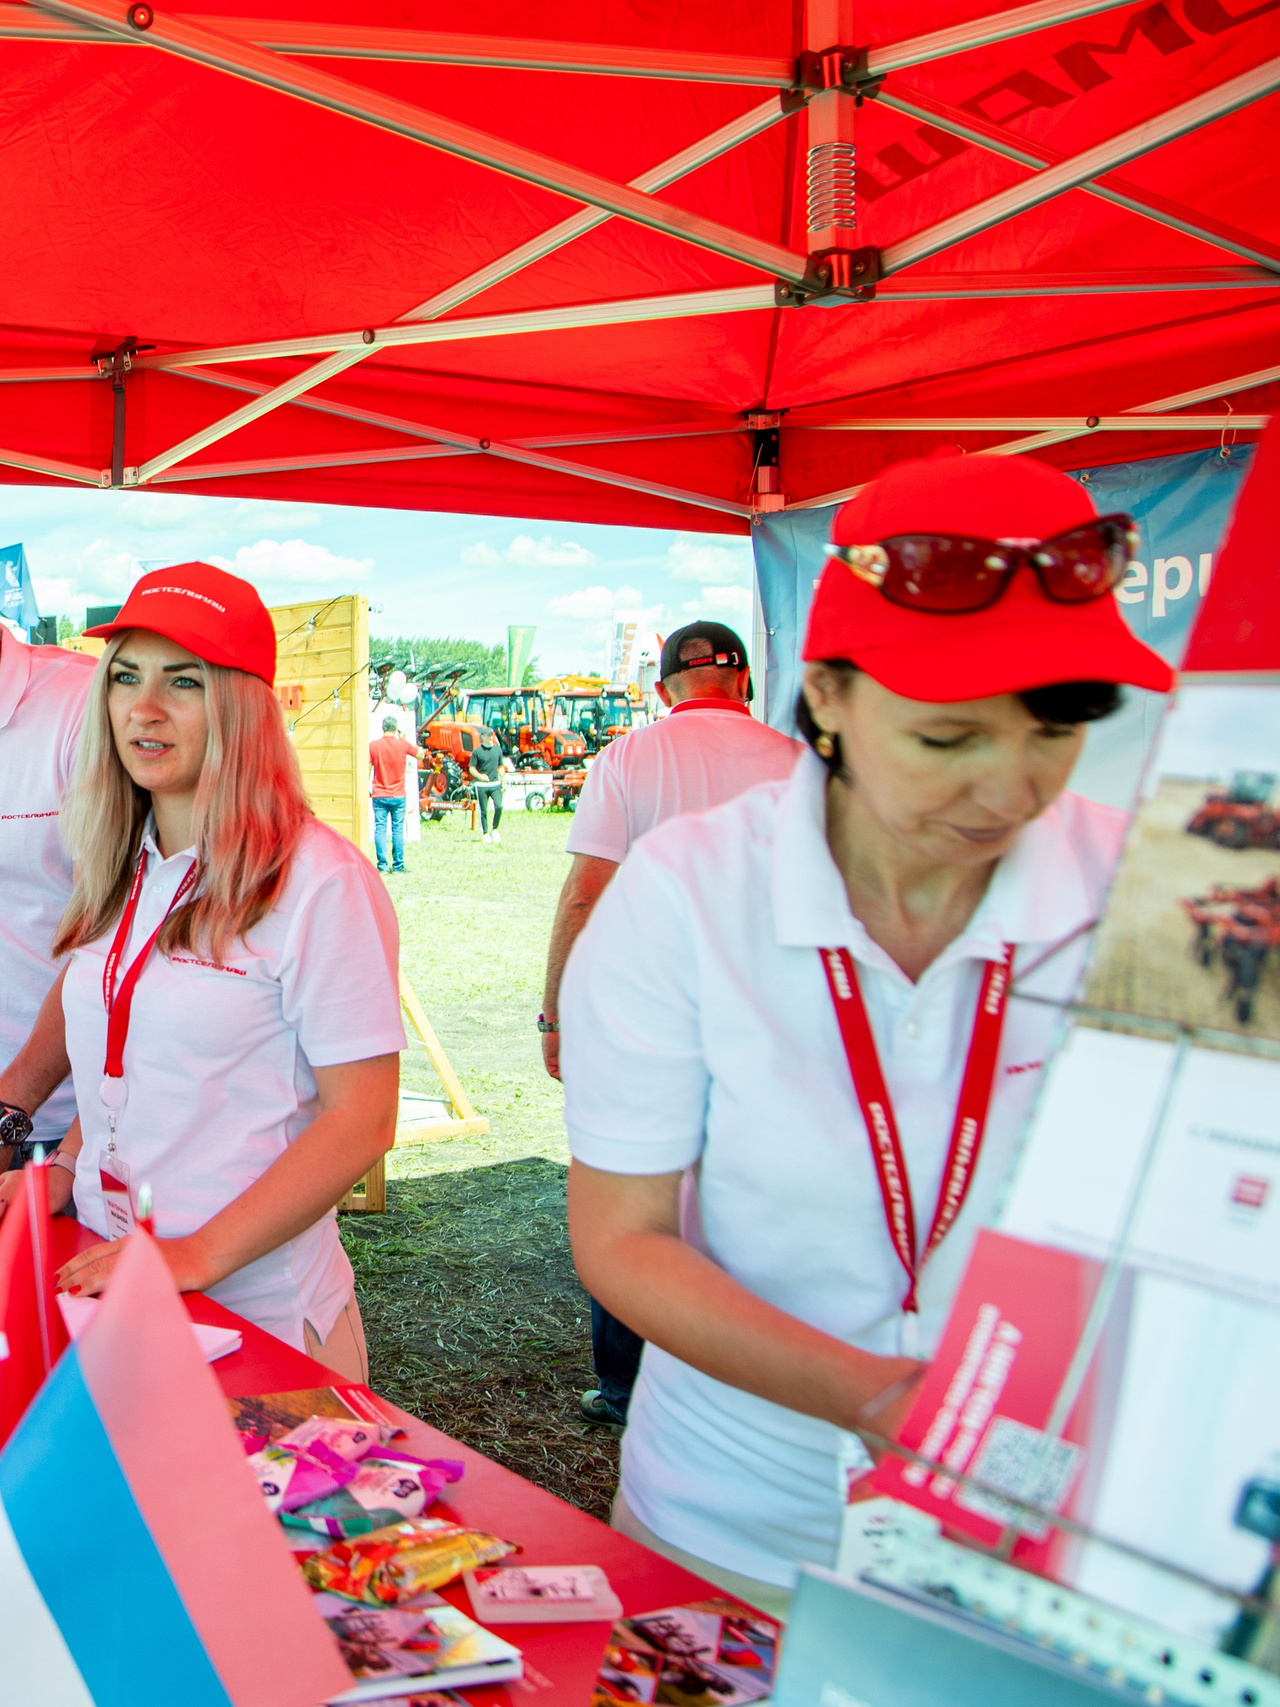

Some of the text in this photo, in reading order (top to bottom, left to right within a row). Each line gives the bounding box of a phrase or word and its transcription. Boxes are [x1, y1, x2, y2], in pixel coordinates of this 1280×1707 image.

[142, 586, 226, 613] РОСТСЕЛЬМАШ
[688, 657, 713, 667] RSM
[172, 957, 247, 975] РОСТСЕЛЬМАШ
